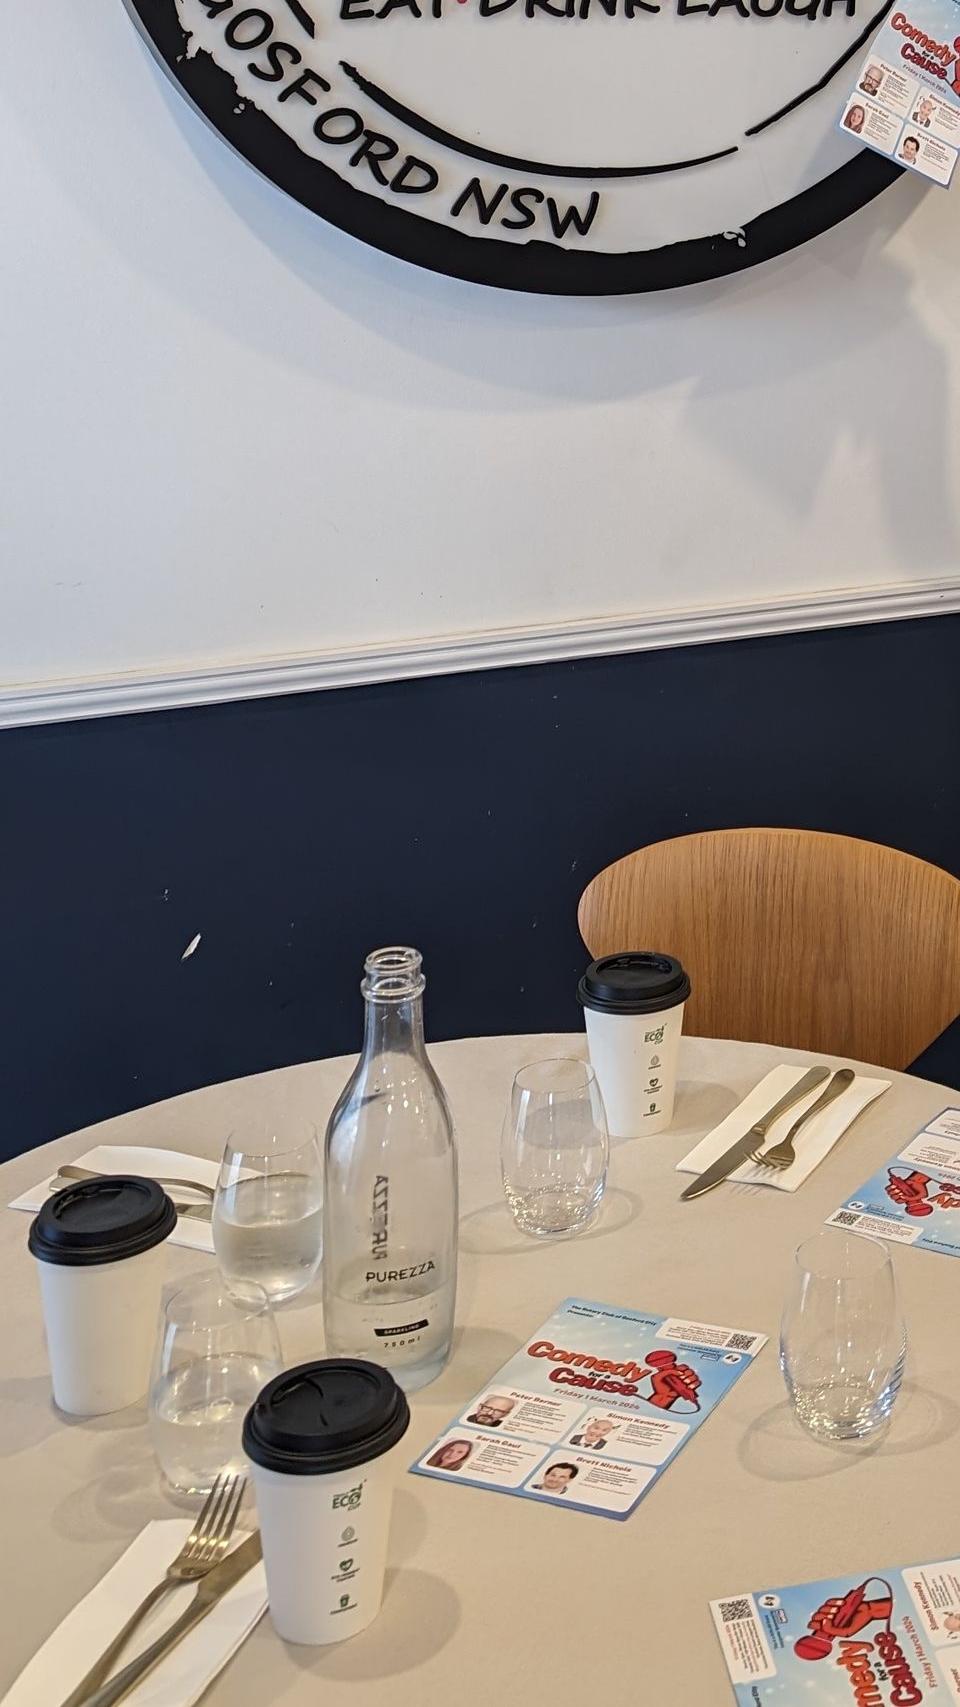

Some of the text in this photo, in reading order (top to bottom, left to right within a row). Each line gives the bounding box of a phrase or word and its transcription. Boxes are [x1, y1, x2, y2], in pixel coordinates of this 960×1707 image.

[891, 12, 957, 67] Comedy
[901, 43, 948, 80] Cause
[451, 178, 600, 240] NSW
[365, 1260, 436, 1283] PUREZZA
[527, 1341, 652, 1383] Comedy
[549, 1367, 639, 1397] Cause
[553, 1388, 585, 1400] Friday
[590, 1395, 619, 1407] March
[618, 1400, 640, 1410] 2024
[901, 1616, 915, 1634] 2024
[910, 1635, 925, 1659] March
[836, 1640, 885, 1707] medy
[873, 1631, 923, 1707] Cause
[922, 1662, 938, 1688] Friday
